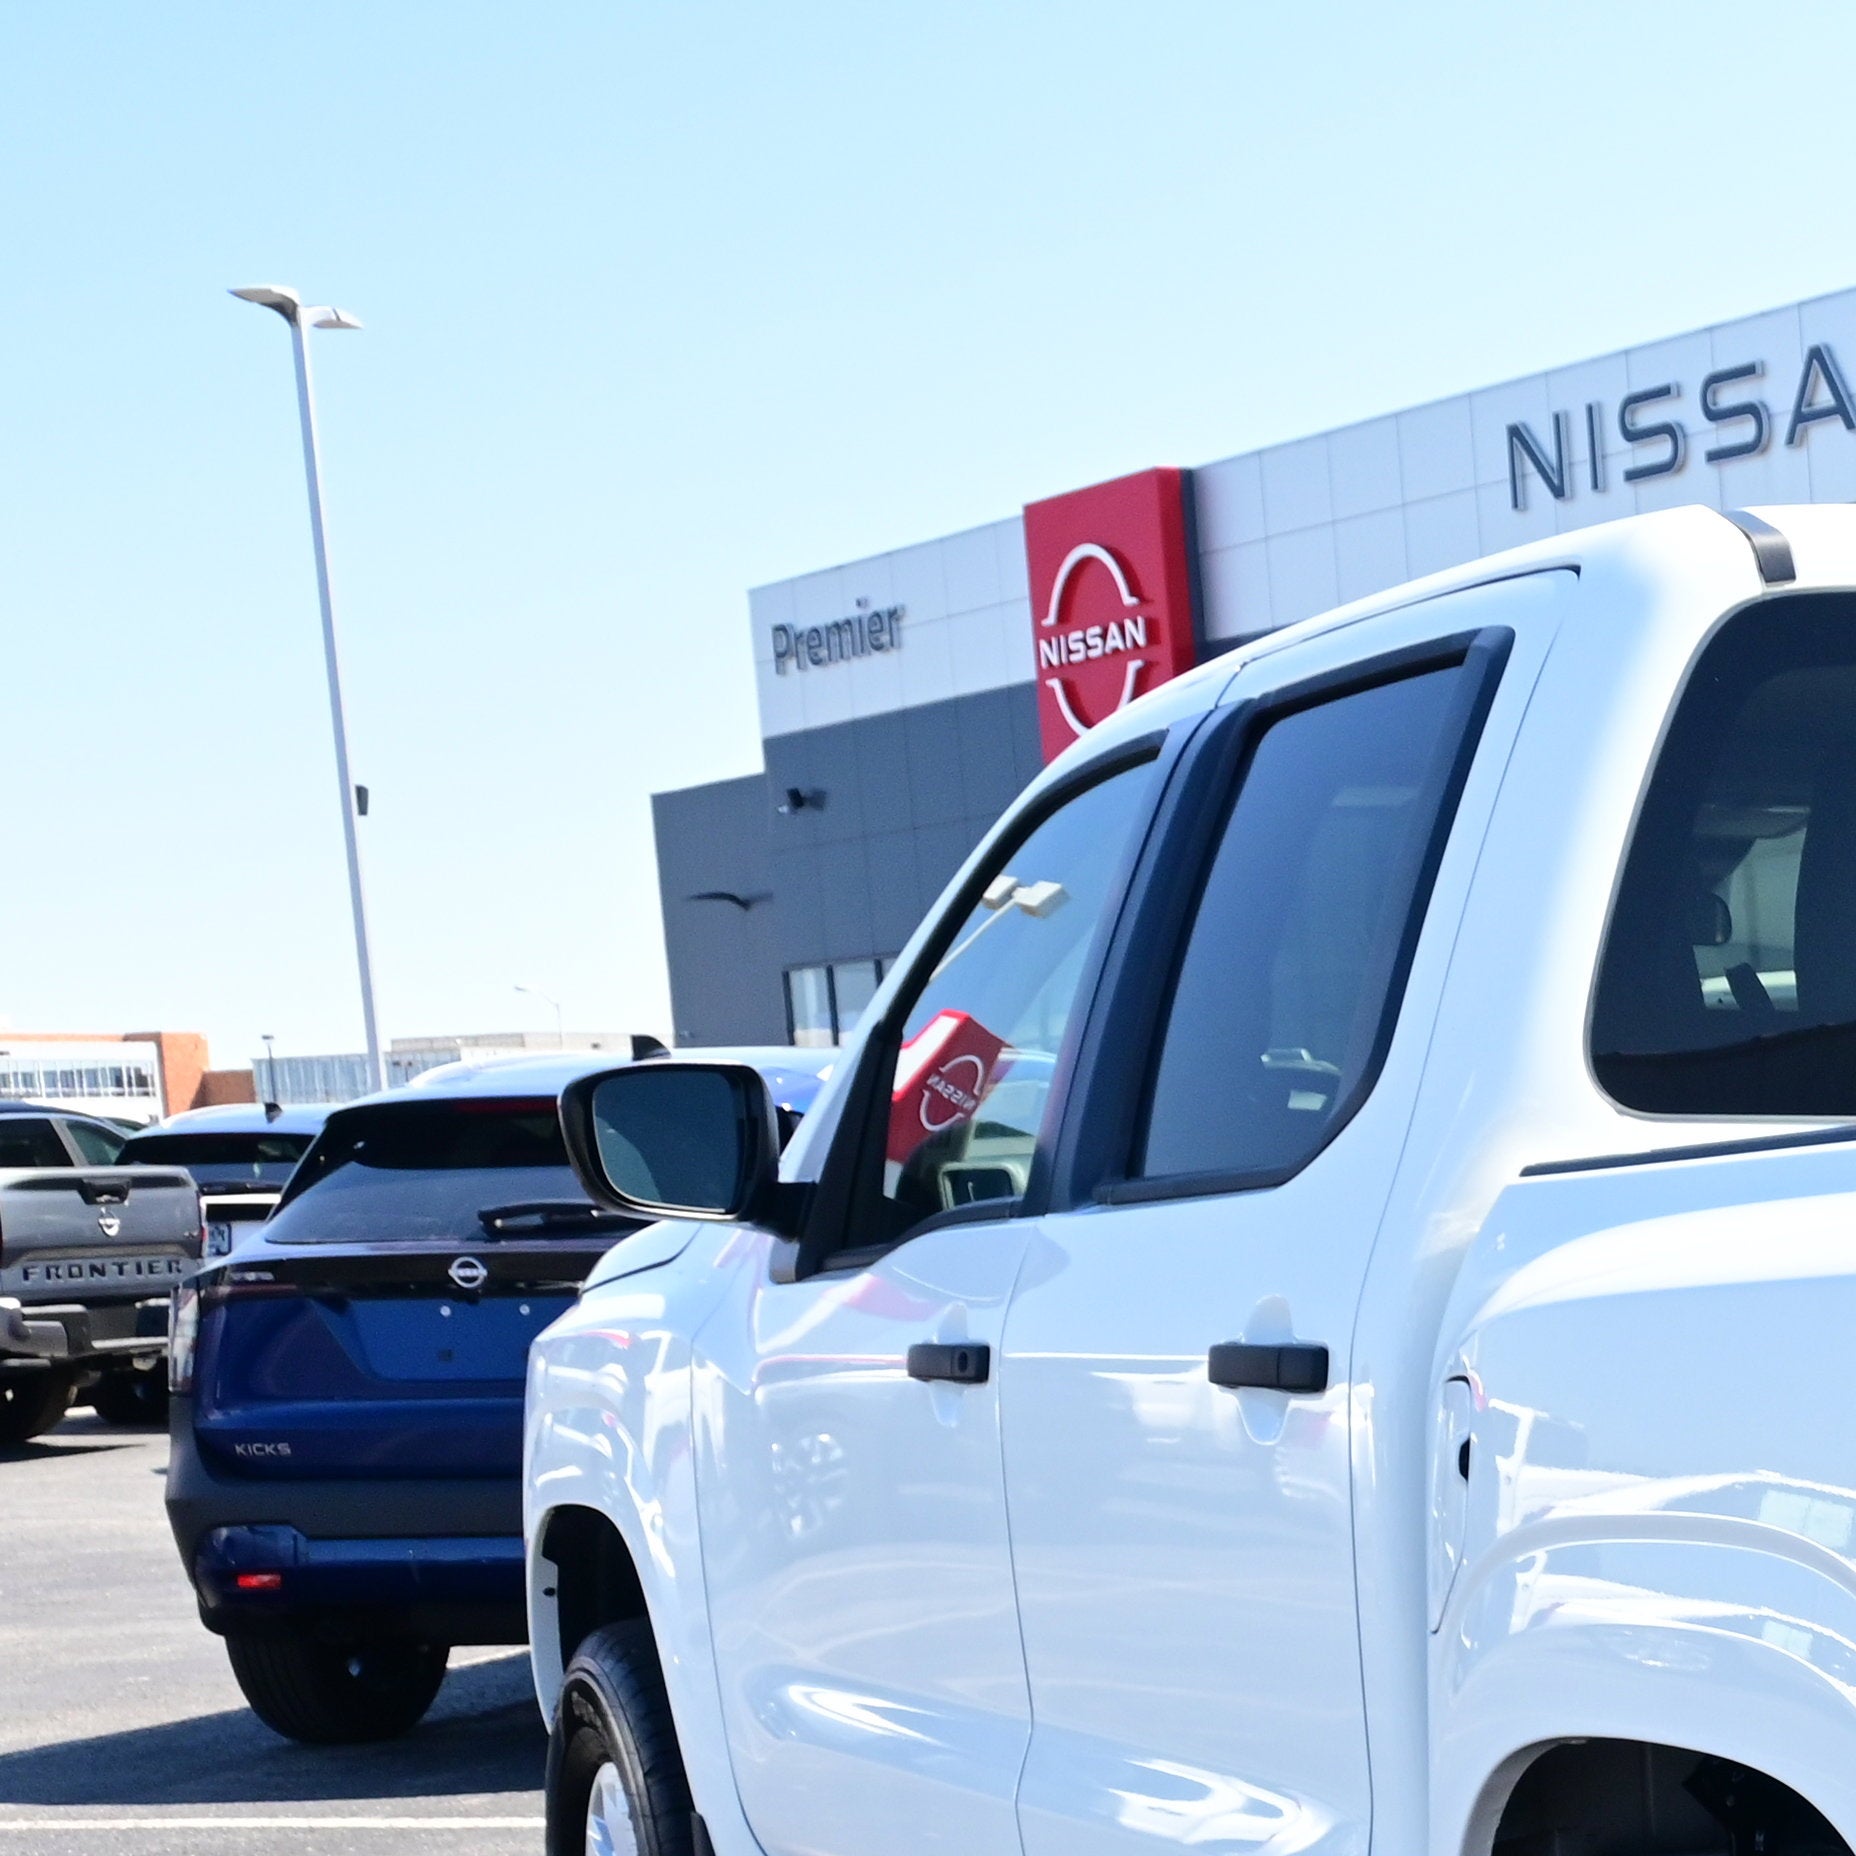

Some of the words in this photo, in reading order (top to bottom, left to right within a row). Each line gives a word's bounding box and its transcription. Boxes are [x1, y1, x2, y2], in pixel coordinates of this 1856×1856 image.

[771, 597, 904, 676] Premier
[1040, 616, 1146, 669] NISSAN
[22, 1260, 183, 1282] FRONTIER
[234, 1443, 292, 1457] KICKS
